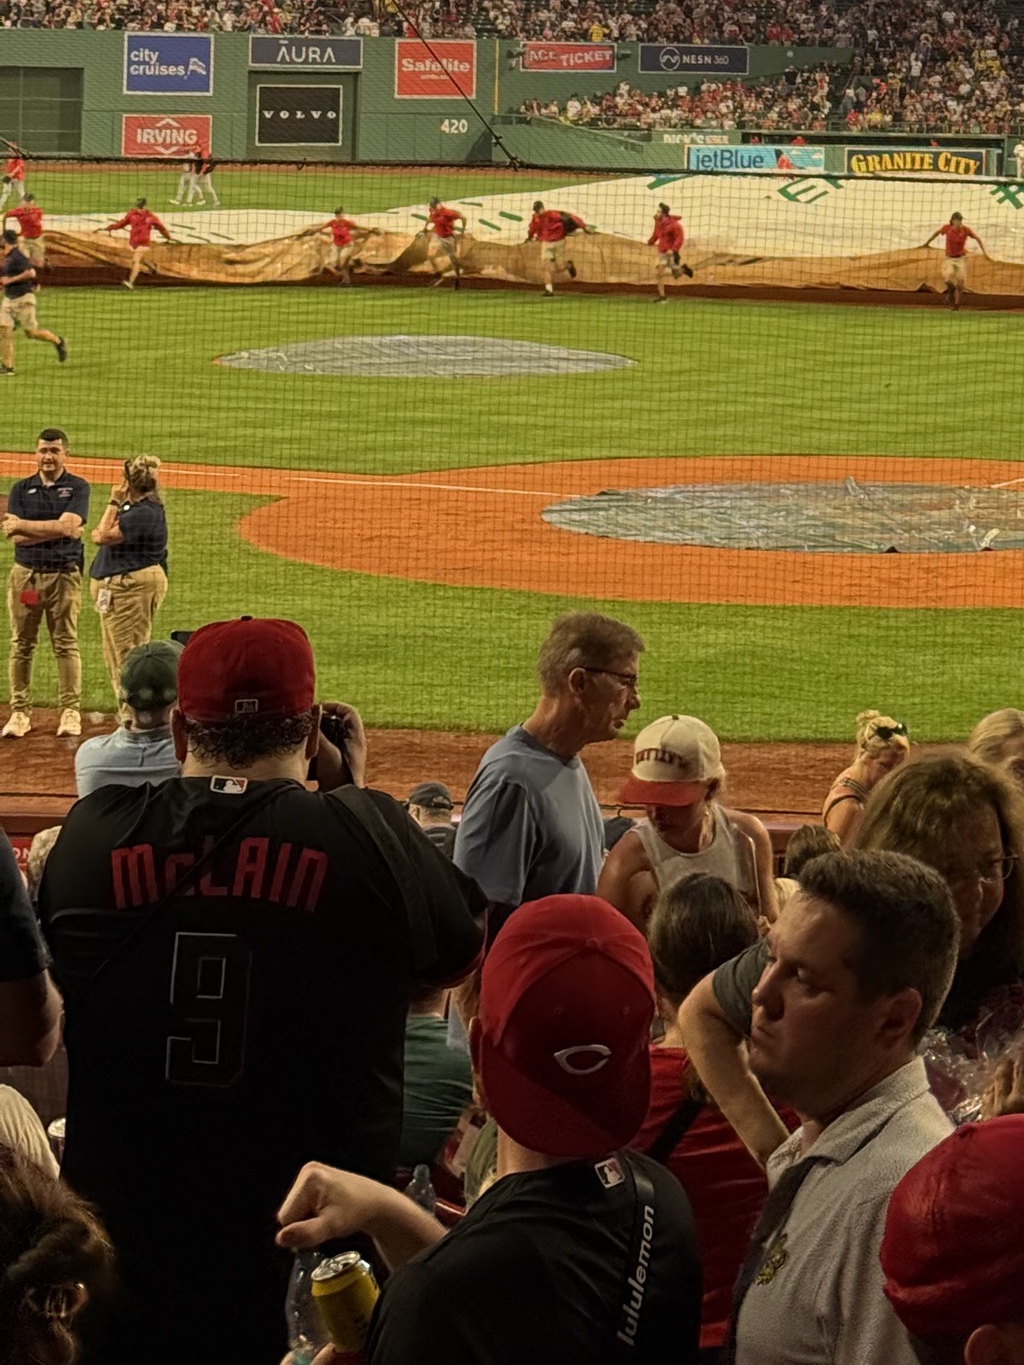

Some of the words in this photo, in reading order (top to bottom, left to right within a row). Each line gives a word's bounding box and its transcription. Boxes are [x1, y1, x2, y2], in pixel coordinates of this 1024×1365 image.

[130, 48, 159, 66] city
[401, 58, 471, 72] Safelite
[560, 50, 613, 66] TICKET
[682, 54, 712, 64] NESN
[713, 56, 729, 65] 360
[129, 63, 185, 75] cruises
[262, 110, 336, 118] VOLVO
[440, 120, 468, 134] 420
[137, 129, 198, 144] IRVING
[696, 149, 764, 170] jetBlue
[850, 152, 933, 173] GRANITE
[937, 152, 979, 174] CITY
[165, 931, 252, 1087] 9
[553, 1044, 612, 1075] C
[617, 1205, 655, 1346] lululemon
